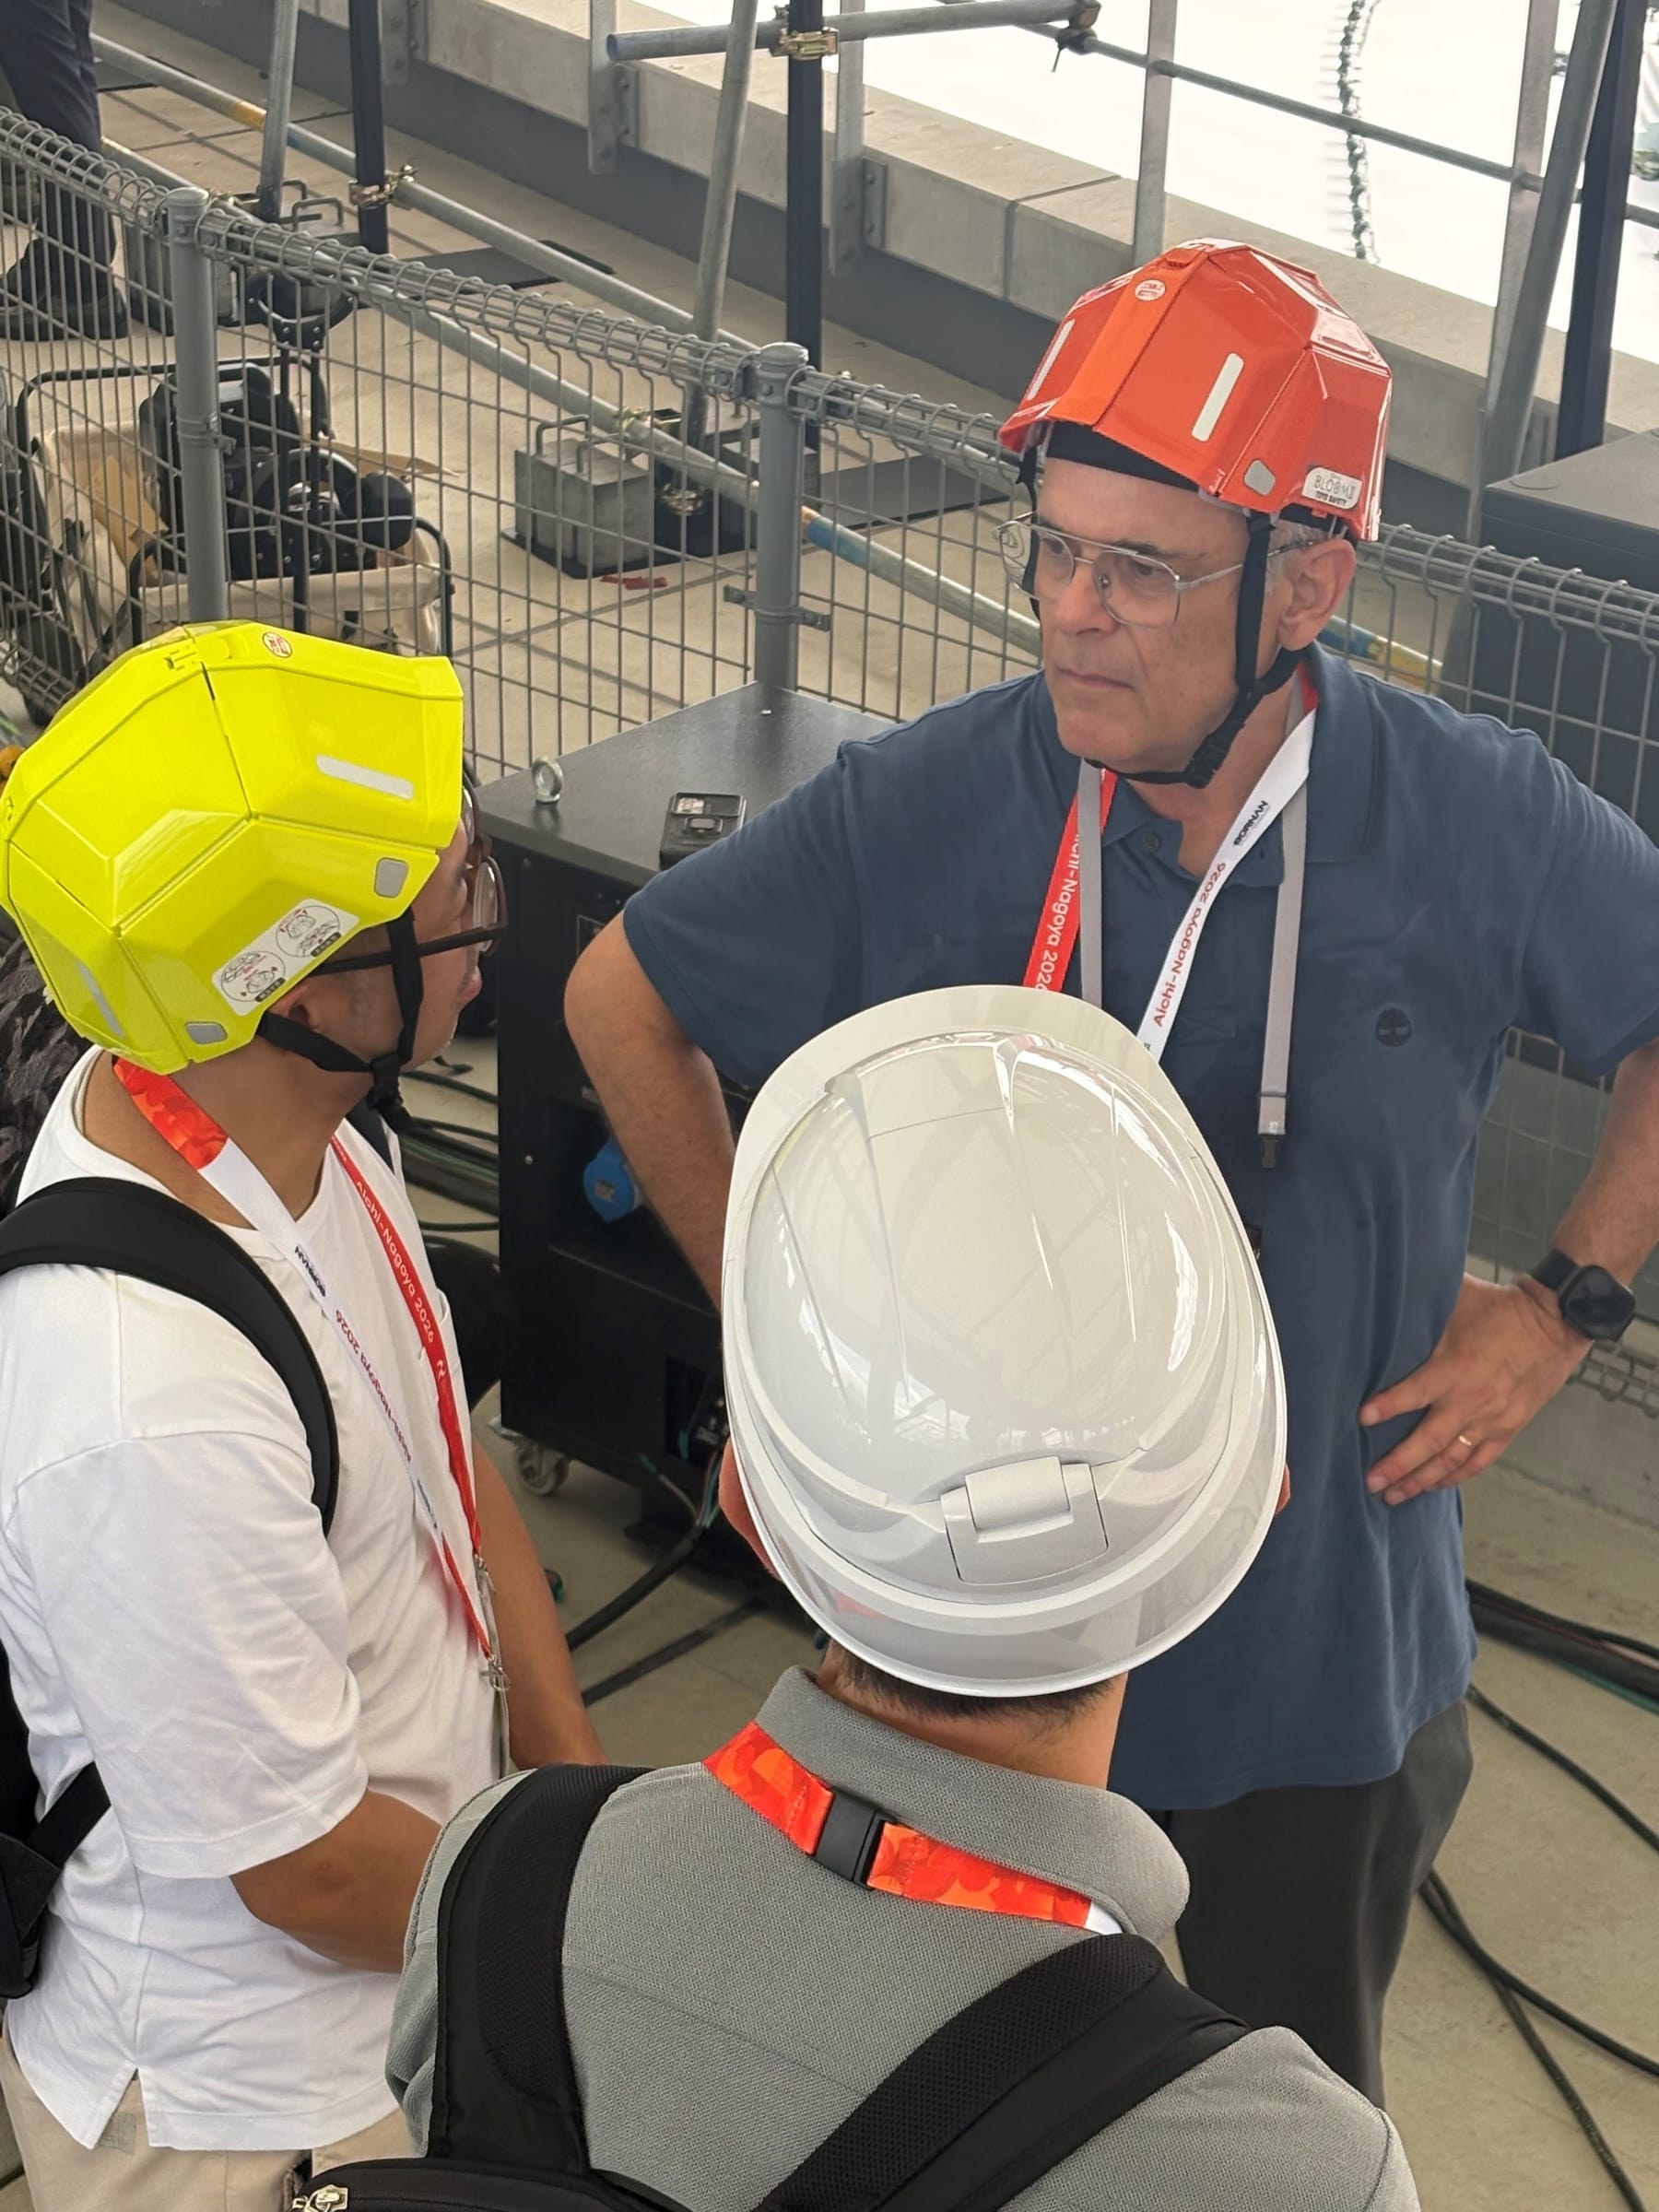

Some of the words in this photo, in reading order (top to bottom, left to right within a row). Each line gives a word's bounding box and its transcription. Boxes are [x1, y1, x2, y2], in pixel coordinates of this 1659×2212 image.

[1233, 800, 1268, 845] BORNAN
[1153, 908, 1202, 1027] Aichi-Nagoya
[1200, 862, 1226, 903] 2026
[357, 1181, 416, 1297] Aichi-Nagoya
[415, 1300, 434, 1343] 2026
[335, 1309, 360, 1354] 2026
